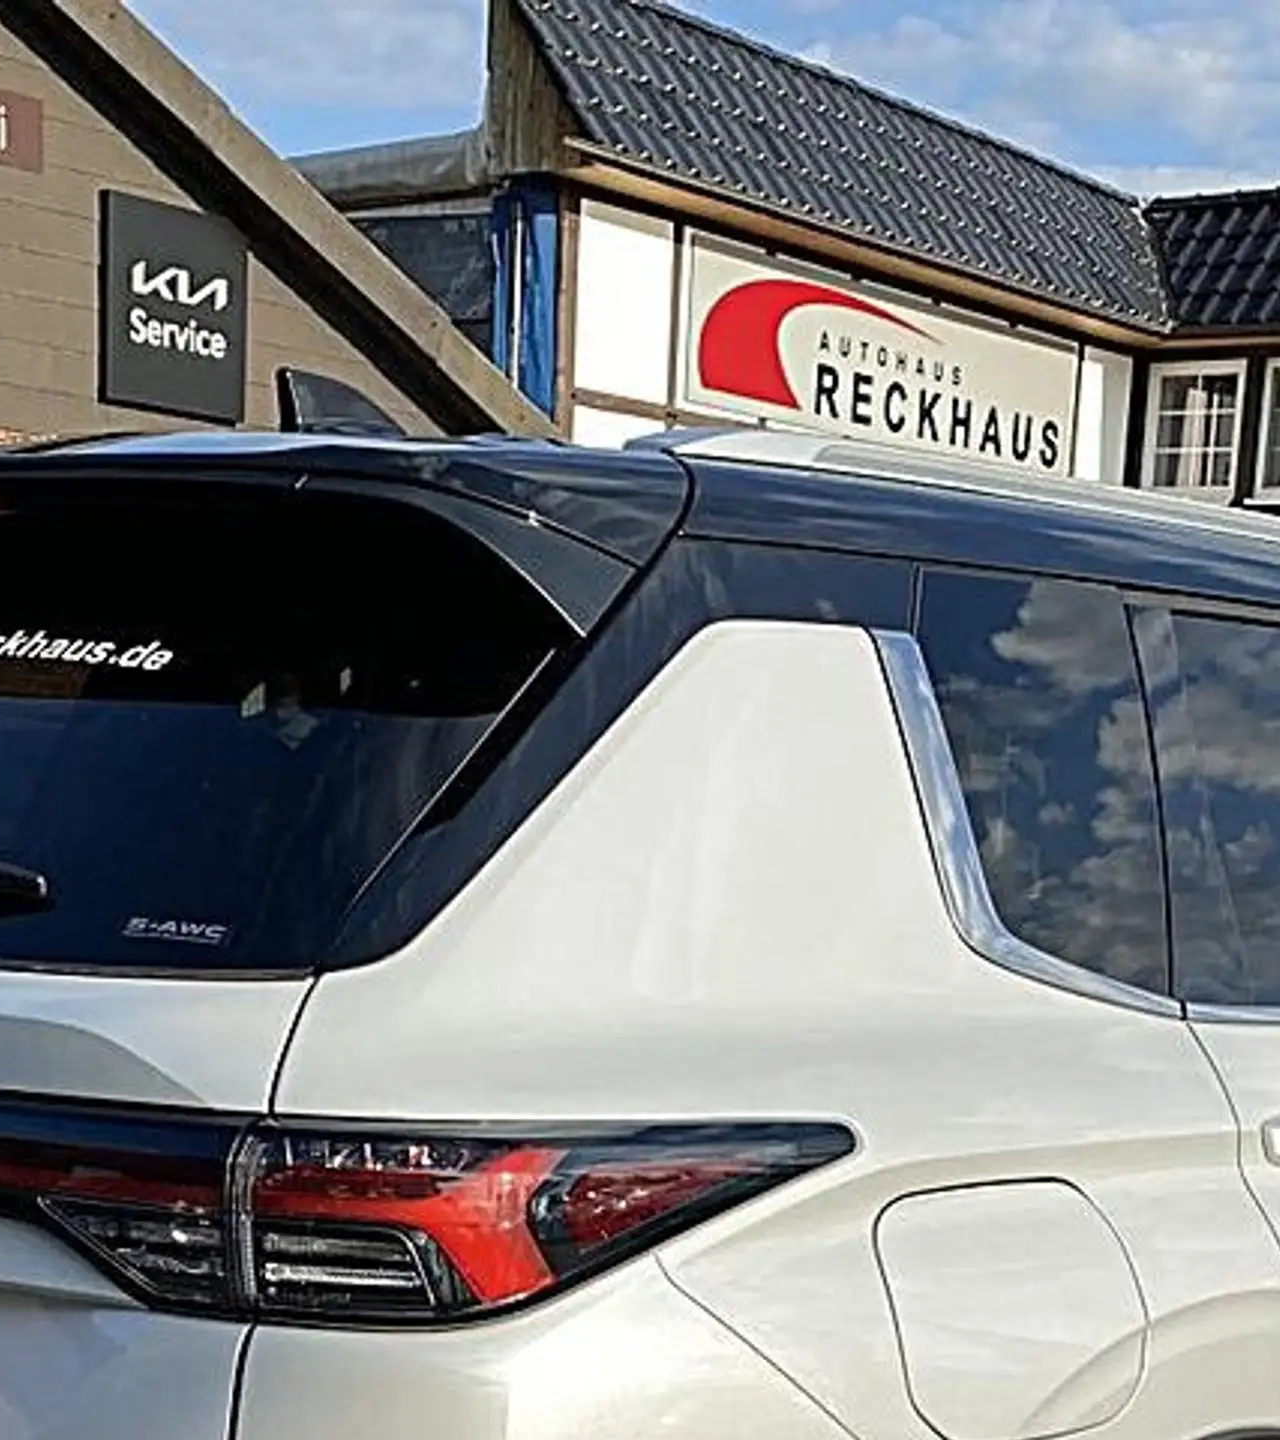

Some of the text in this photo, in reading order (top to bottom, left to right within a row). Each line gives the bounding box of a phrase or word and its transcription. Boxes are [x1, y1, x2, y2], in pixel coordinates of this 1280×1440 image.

[129, 307, 227, 359] Service
[817, 330, 963, 386] AUTOHAUS
[814, 362, 1060, 469] RECKHAUS
